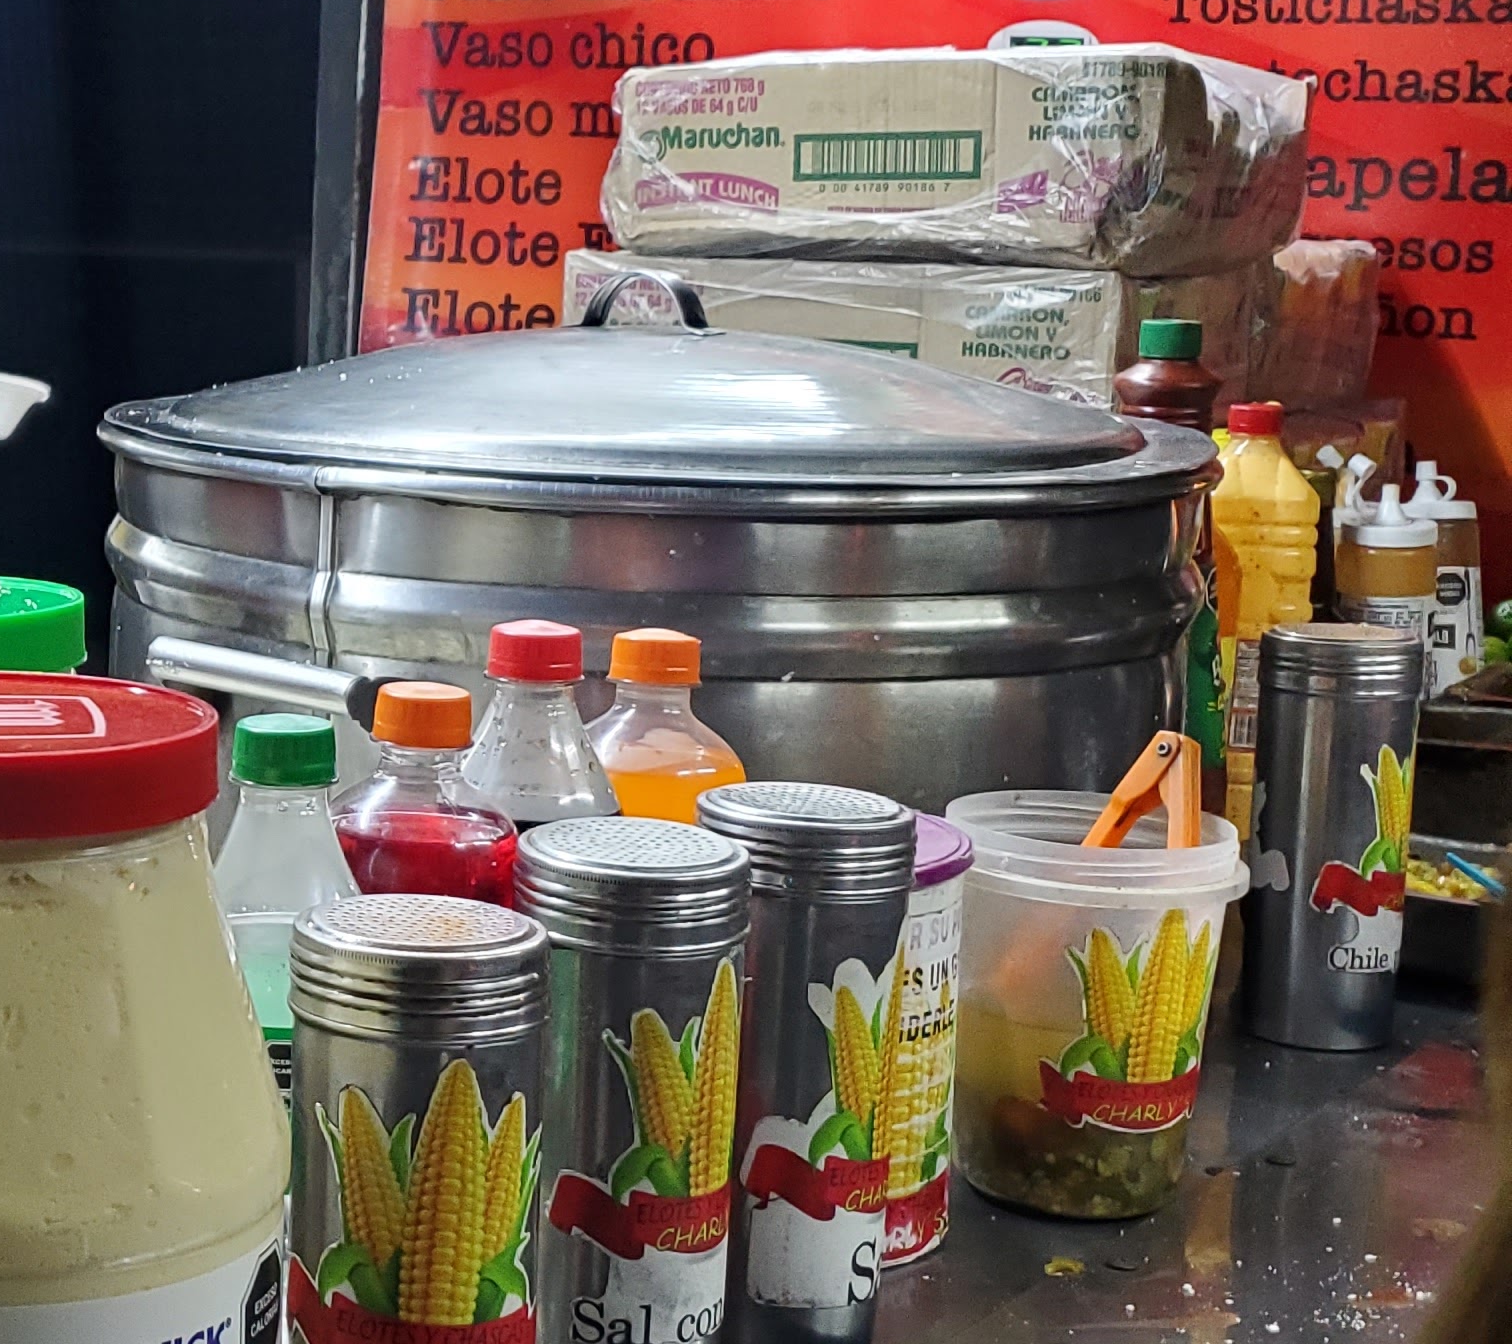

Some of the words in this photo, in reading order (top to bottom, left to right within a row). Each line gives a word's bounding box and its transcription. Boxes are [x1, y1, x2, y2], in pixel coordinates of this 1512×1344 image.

[420, 21, 567, 69] Vaso
[569, 23, 715, 69] chico
[418, 88, 554, 137] Vaso
[661, 122, 781, 150] Maruchan
[409, 157, 561, 204] Elote
[718, 179, 776, 209] LUNCH
[403, 218, 559, 267] Elote
[402, 288, 556, 335] Elote
[1329, 946, 1388, 971] Chile
[848, 1234, 881, 1306] S
